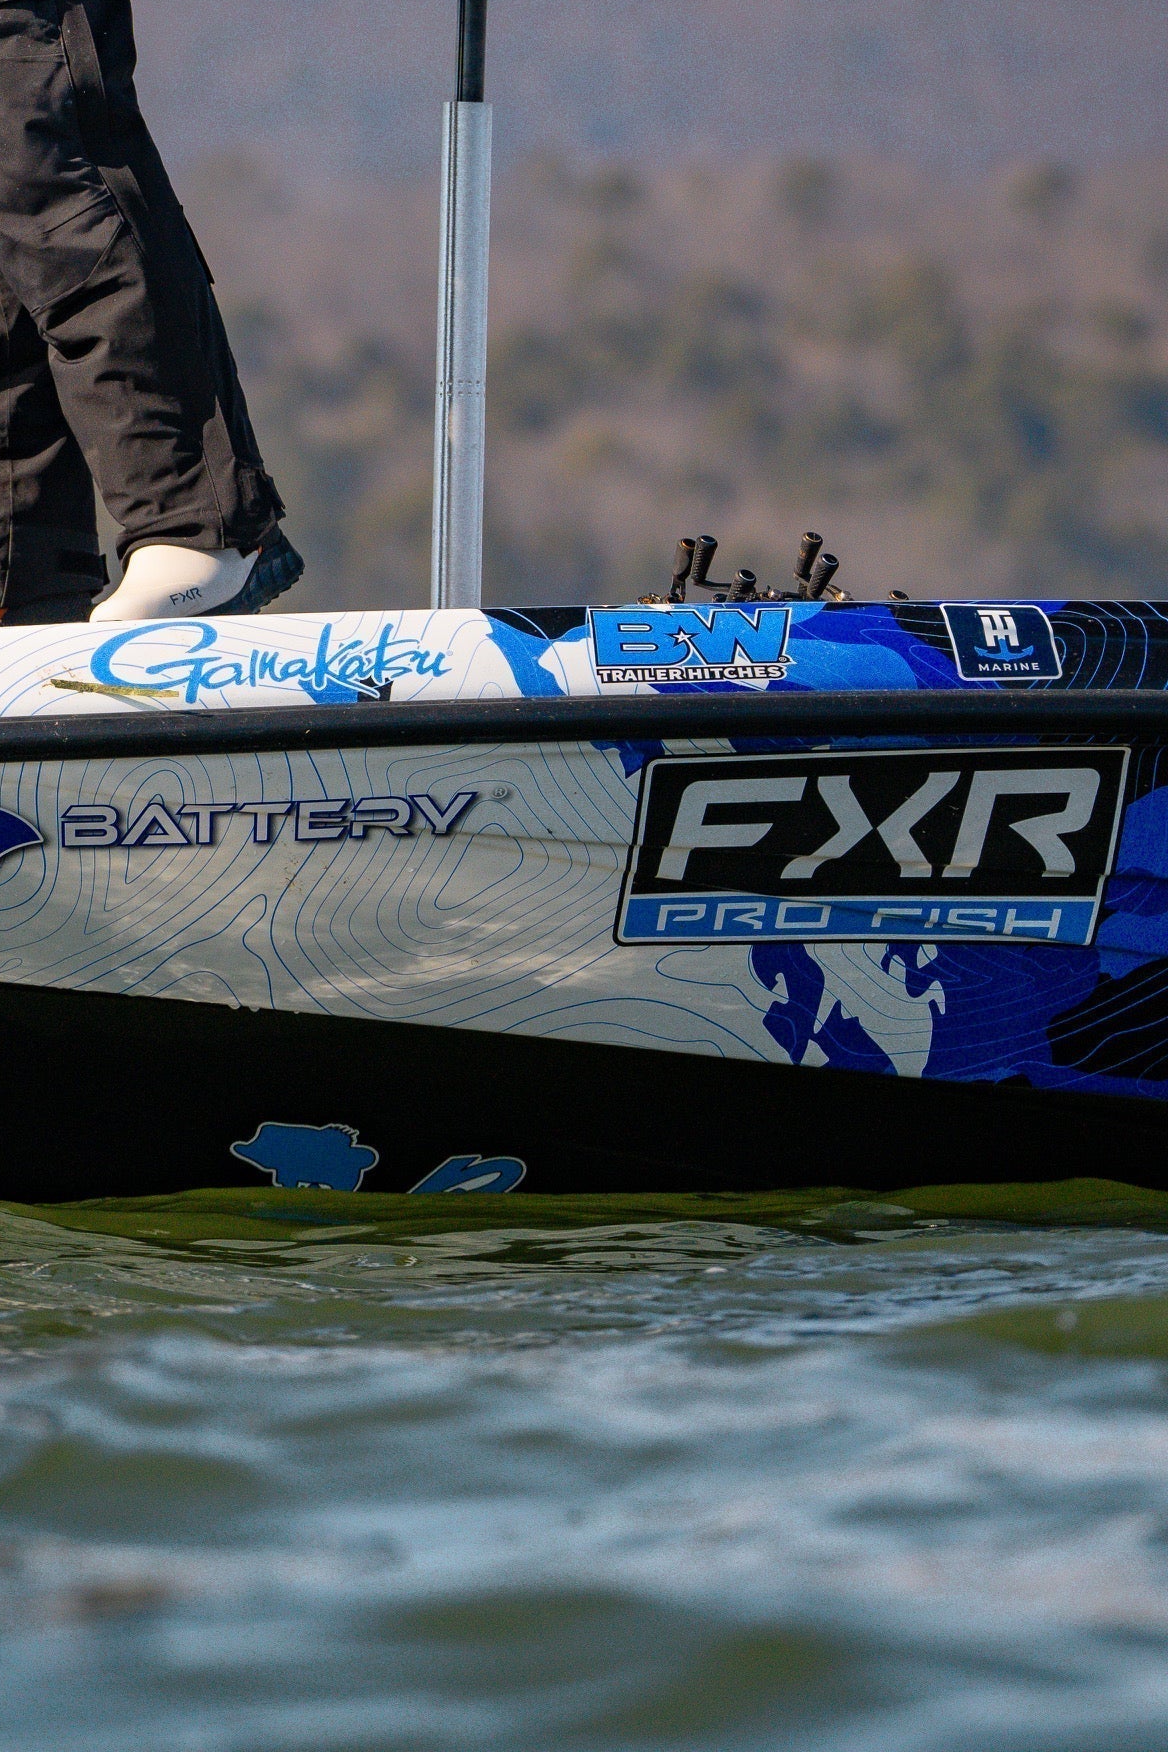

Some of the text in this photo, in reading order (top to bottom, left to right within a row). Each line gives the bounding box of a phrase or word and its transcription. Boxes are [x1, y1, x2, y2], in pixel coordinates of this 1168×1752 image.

[169, 587, 202, 606] FXR
[90, 621, 453, 704] Gamakatsu
[599, 665, 783, 683] TRAILER HITCHES
[978, 662, 1040, 672] MARINE
[60, 791, 480, 848] BATTERY
[655, 767, 1101, 881] FXR
[656, 901, 1061, 940] PRO FISH
